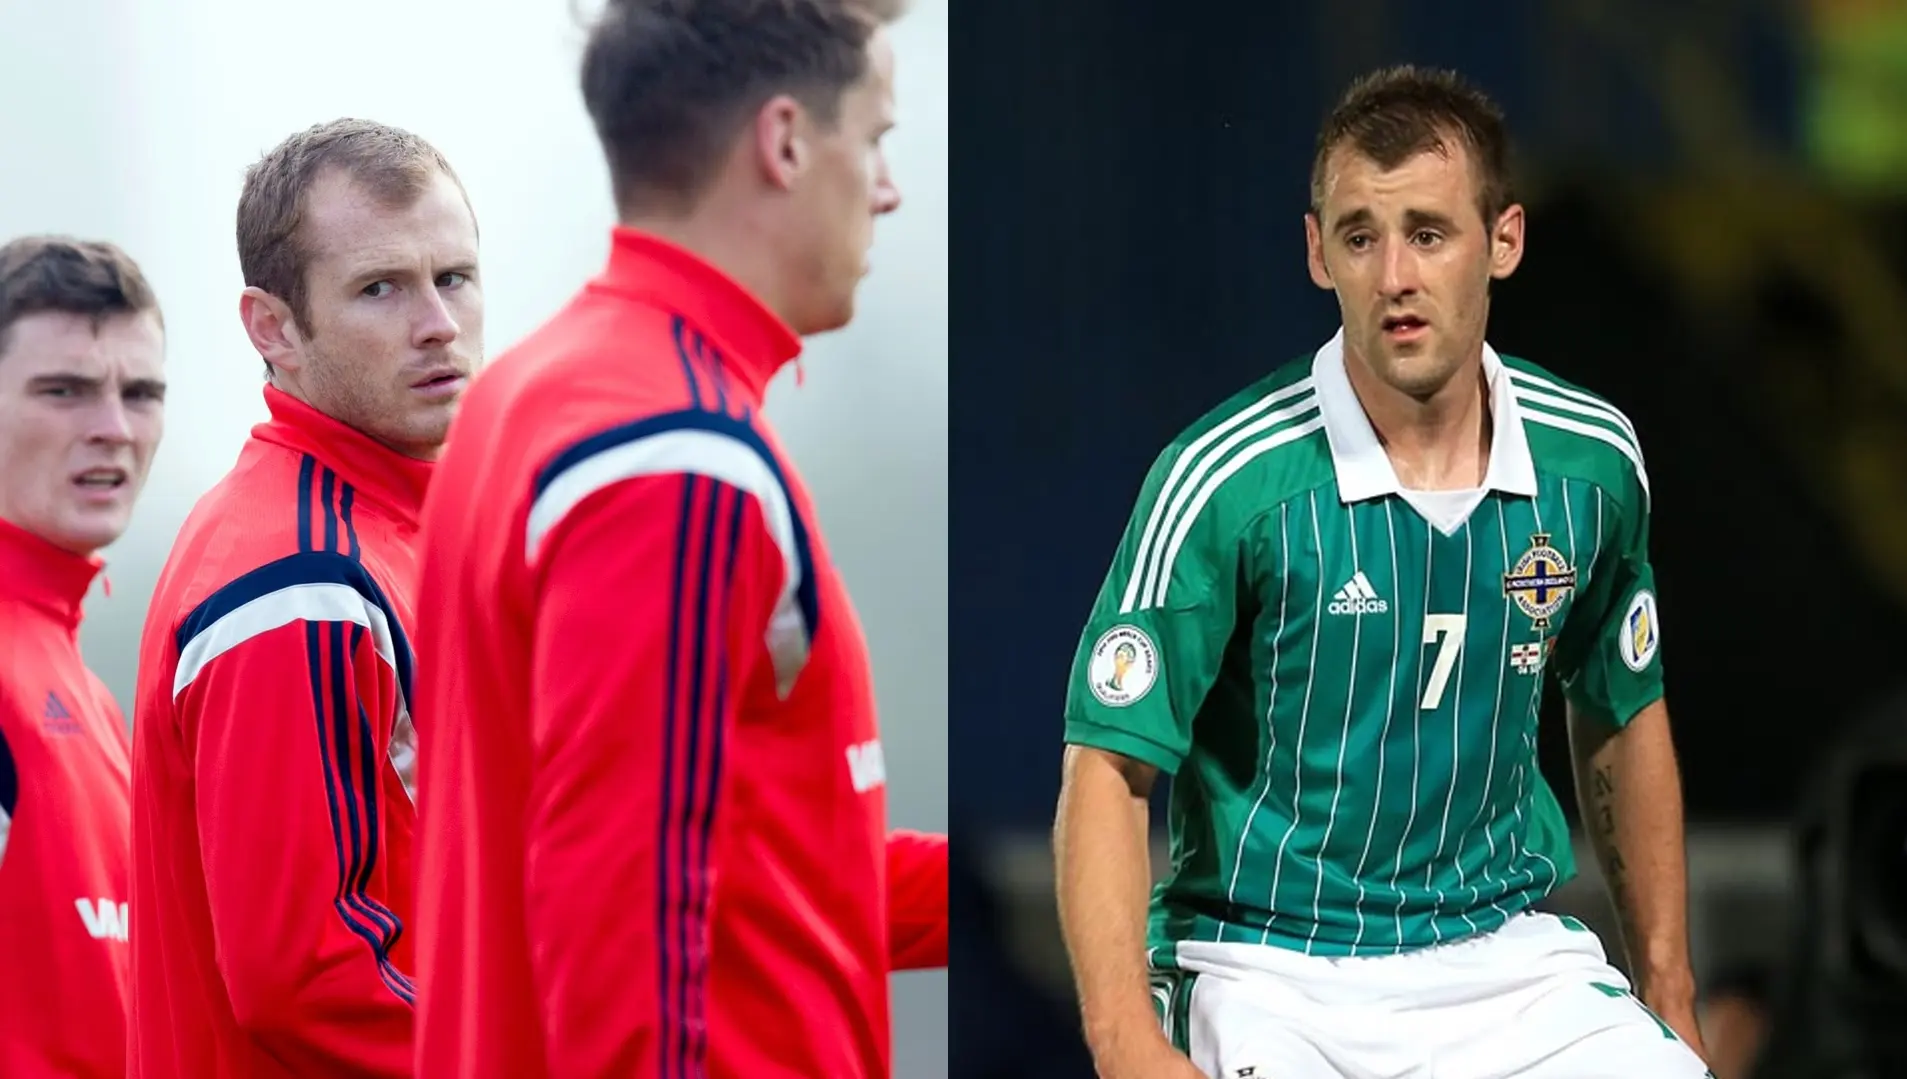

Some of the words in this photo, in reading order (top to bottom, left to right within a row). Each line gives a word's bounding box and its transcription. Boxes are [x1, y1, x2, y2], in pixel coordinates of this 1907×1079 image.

[1531, 549, 1567, 573] FOOTBALL
[1328, 599, 1388, 615] adidas
[1518, 595, 1564, 616] ASSOCIATION
[1420, 614, 1466, 709] 7
